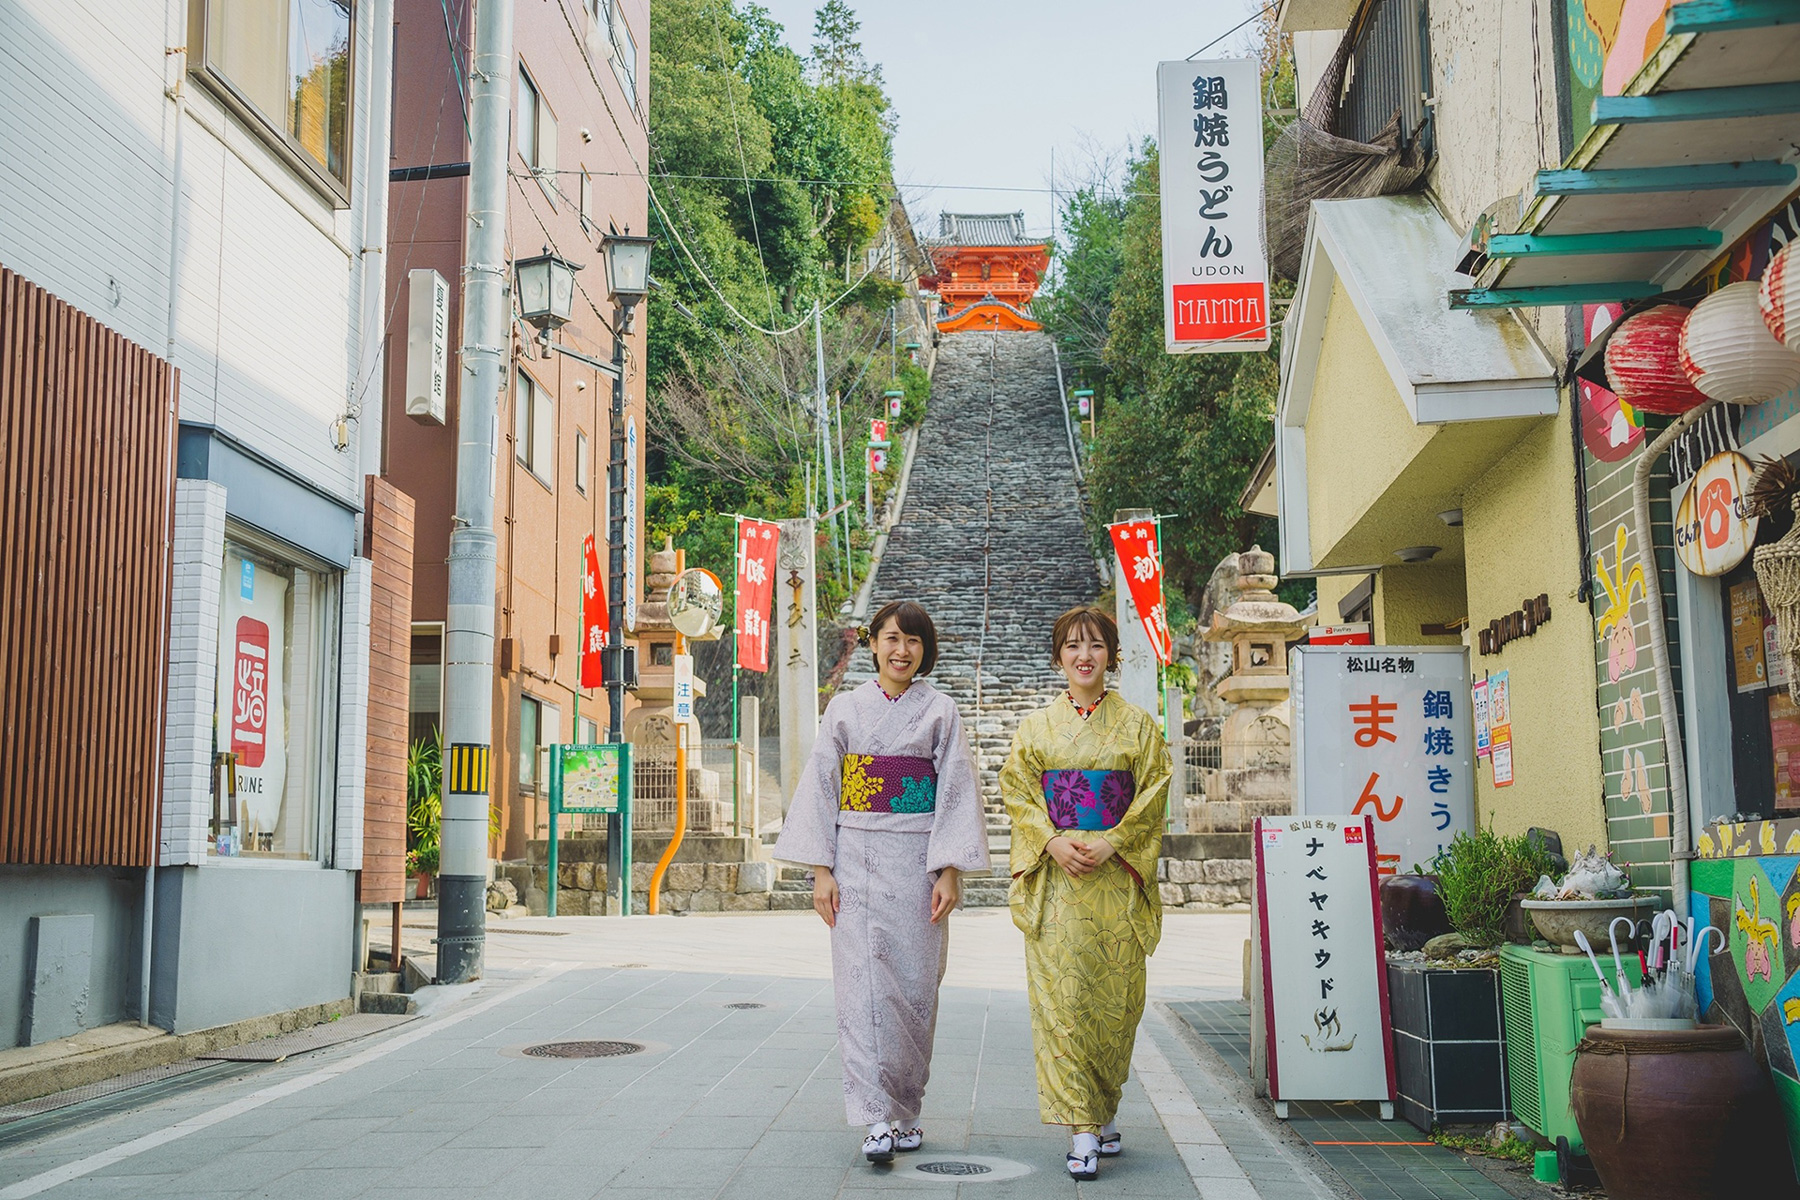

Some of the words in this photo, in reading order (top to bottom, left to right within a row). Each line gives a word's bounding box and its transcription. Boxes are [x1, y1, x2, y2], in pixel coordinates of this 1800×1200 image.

[1192, 76, 1233, 259] 鍋焼うどん
[1192, 265, 1244, 277] UDON
[1177, 298, 1261, 325] MAMMA
[1676, 520, 1701, 547] でんわ
[1346, 656, 1415, 673] 松山名物
[677, 682, 691, 718] 注意
[1289, 819, 1337, 832] 松山名物
[1305, 837, 1337, 1027] ナベヤキウドン
